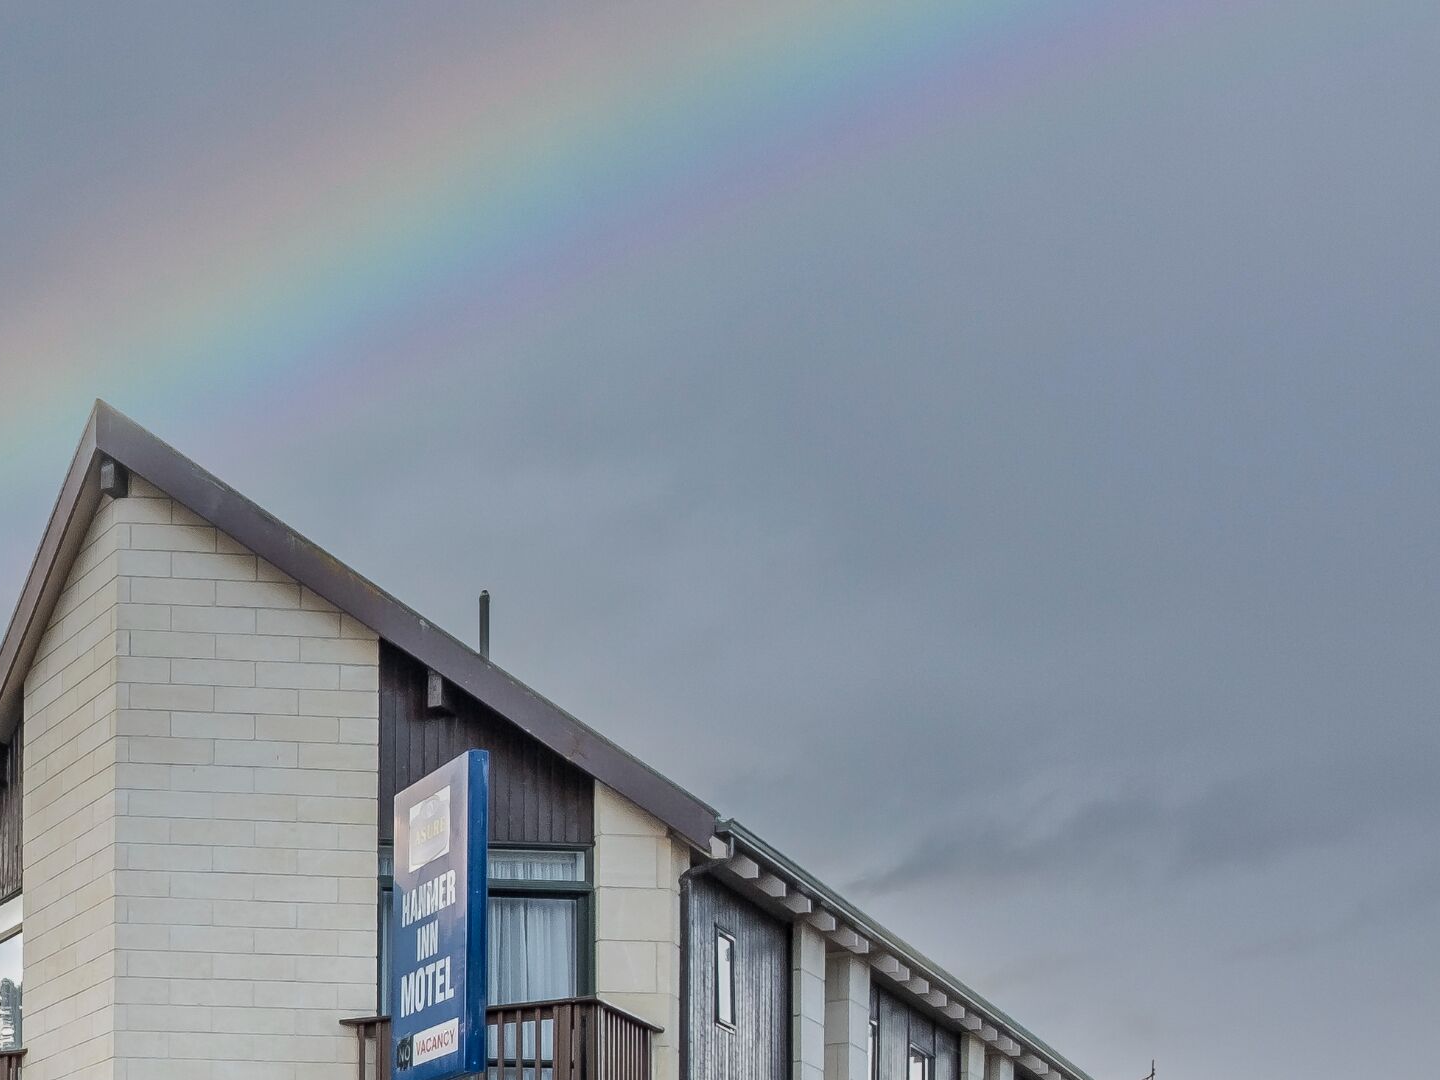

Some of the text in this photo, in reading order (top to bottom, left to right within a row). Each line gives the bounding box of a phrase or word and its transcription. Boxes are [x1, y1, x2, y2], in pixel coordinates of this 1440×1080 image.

[415, 816, 446, 846] ASURE
[402, 869, 456, 928] HANMER
[416, 919, 439, 961] INN
[400, 956, 455, 1018] MOTEL
[415, 1028, 456, 1056] VACANCY
